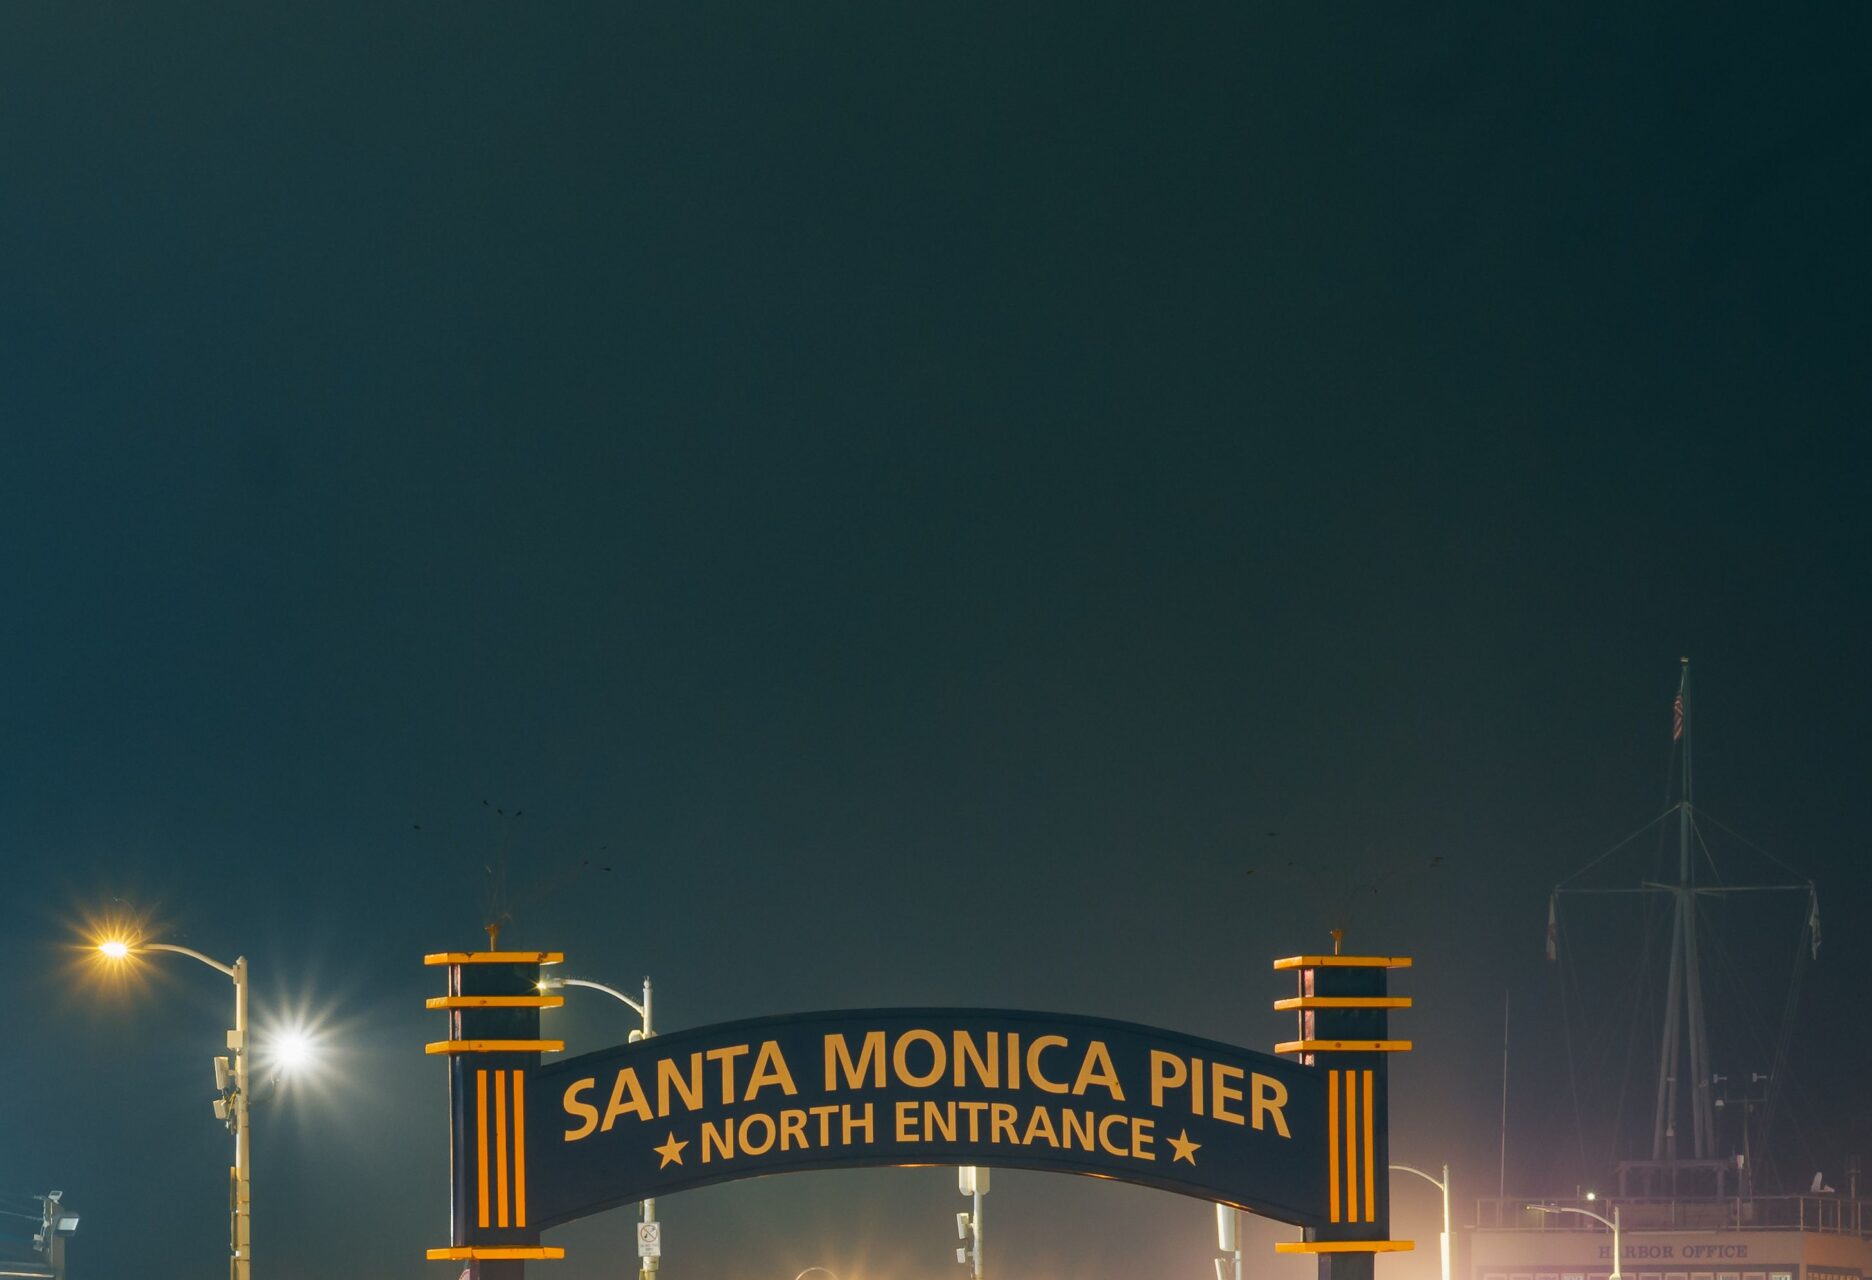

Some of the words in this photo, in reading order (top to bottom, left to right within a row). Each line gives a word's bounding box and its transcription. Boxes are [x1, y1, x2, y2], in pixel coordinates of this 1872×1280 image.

[563, 1040, 798, 1142] SANTA
[824, 1029, 1126, 1101] MONICA
[1150, 1049, 1292, 1139] PIER
[702, 1102, 874, 1164] NORTH
[895, 1101, 1156, 1161] ENTRANCE
[1682, 1245, 1748, 1259] OFFICE
